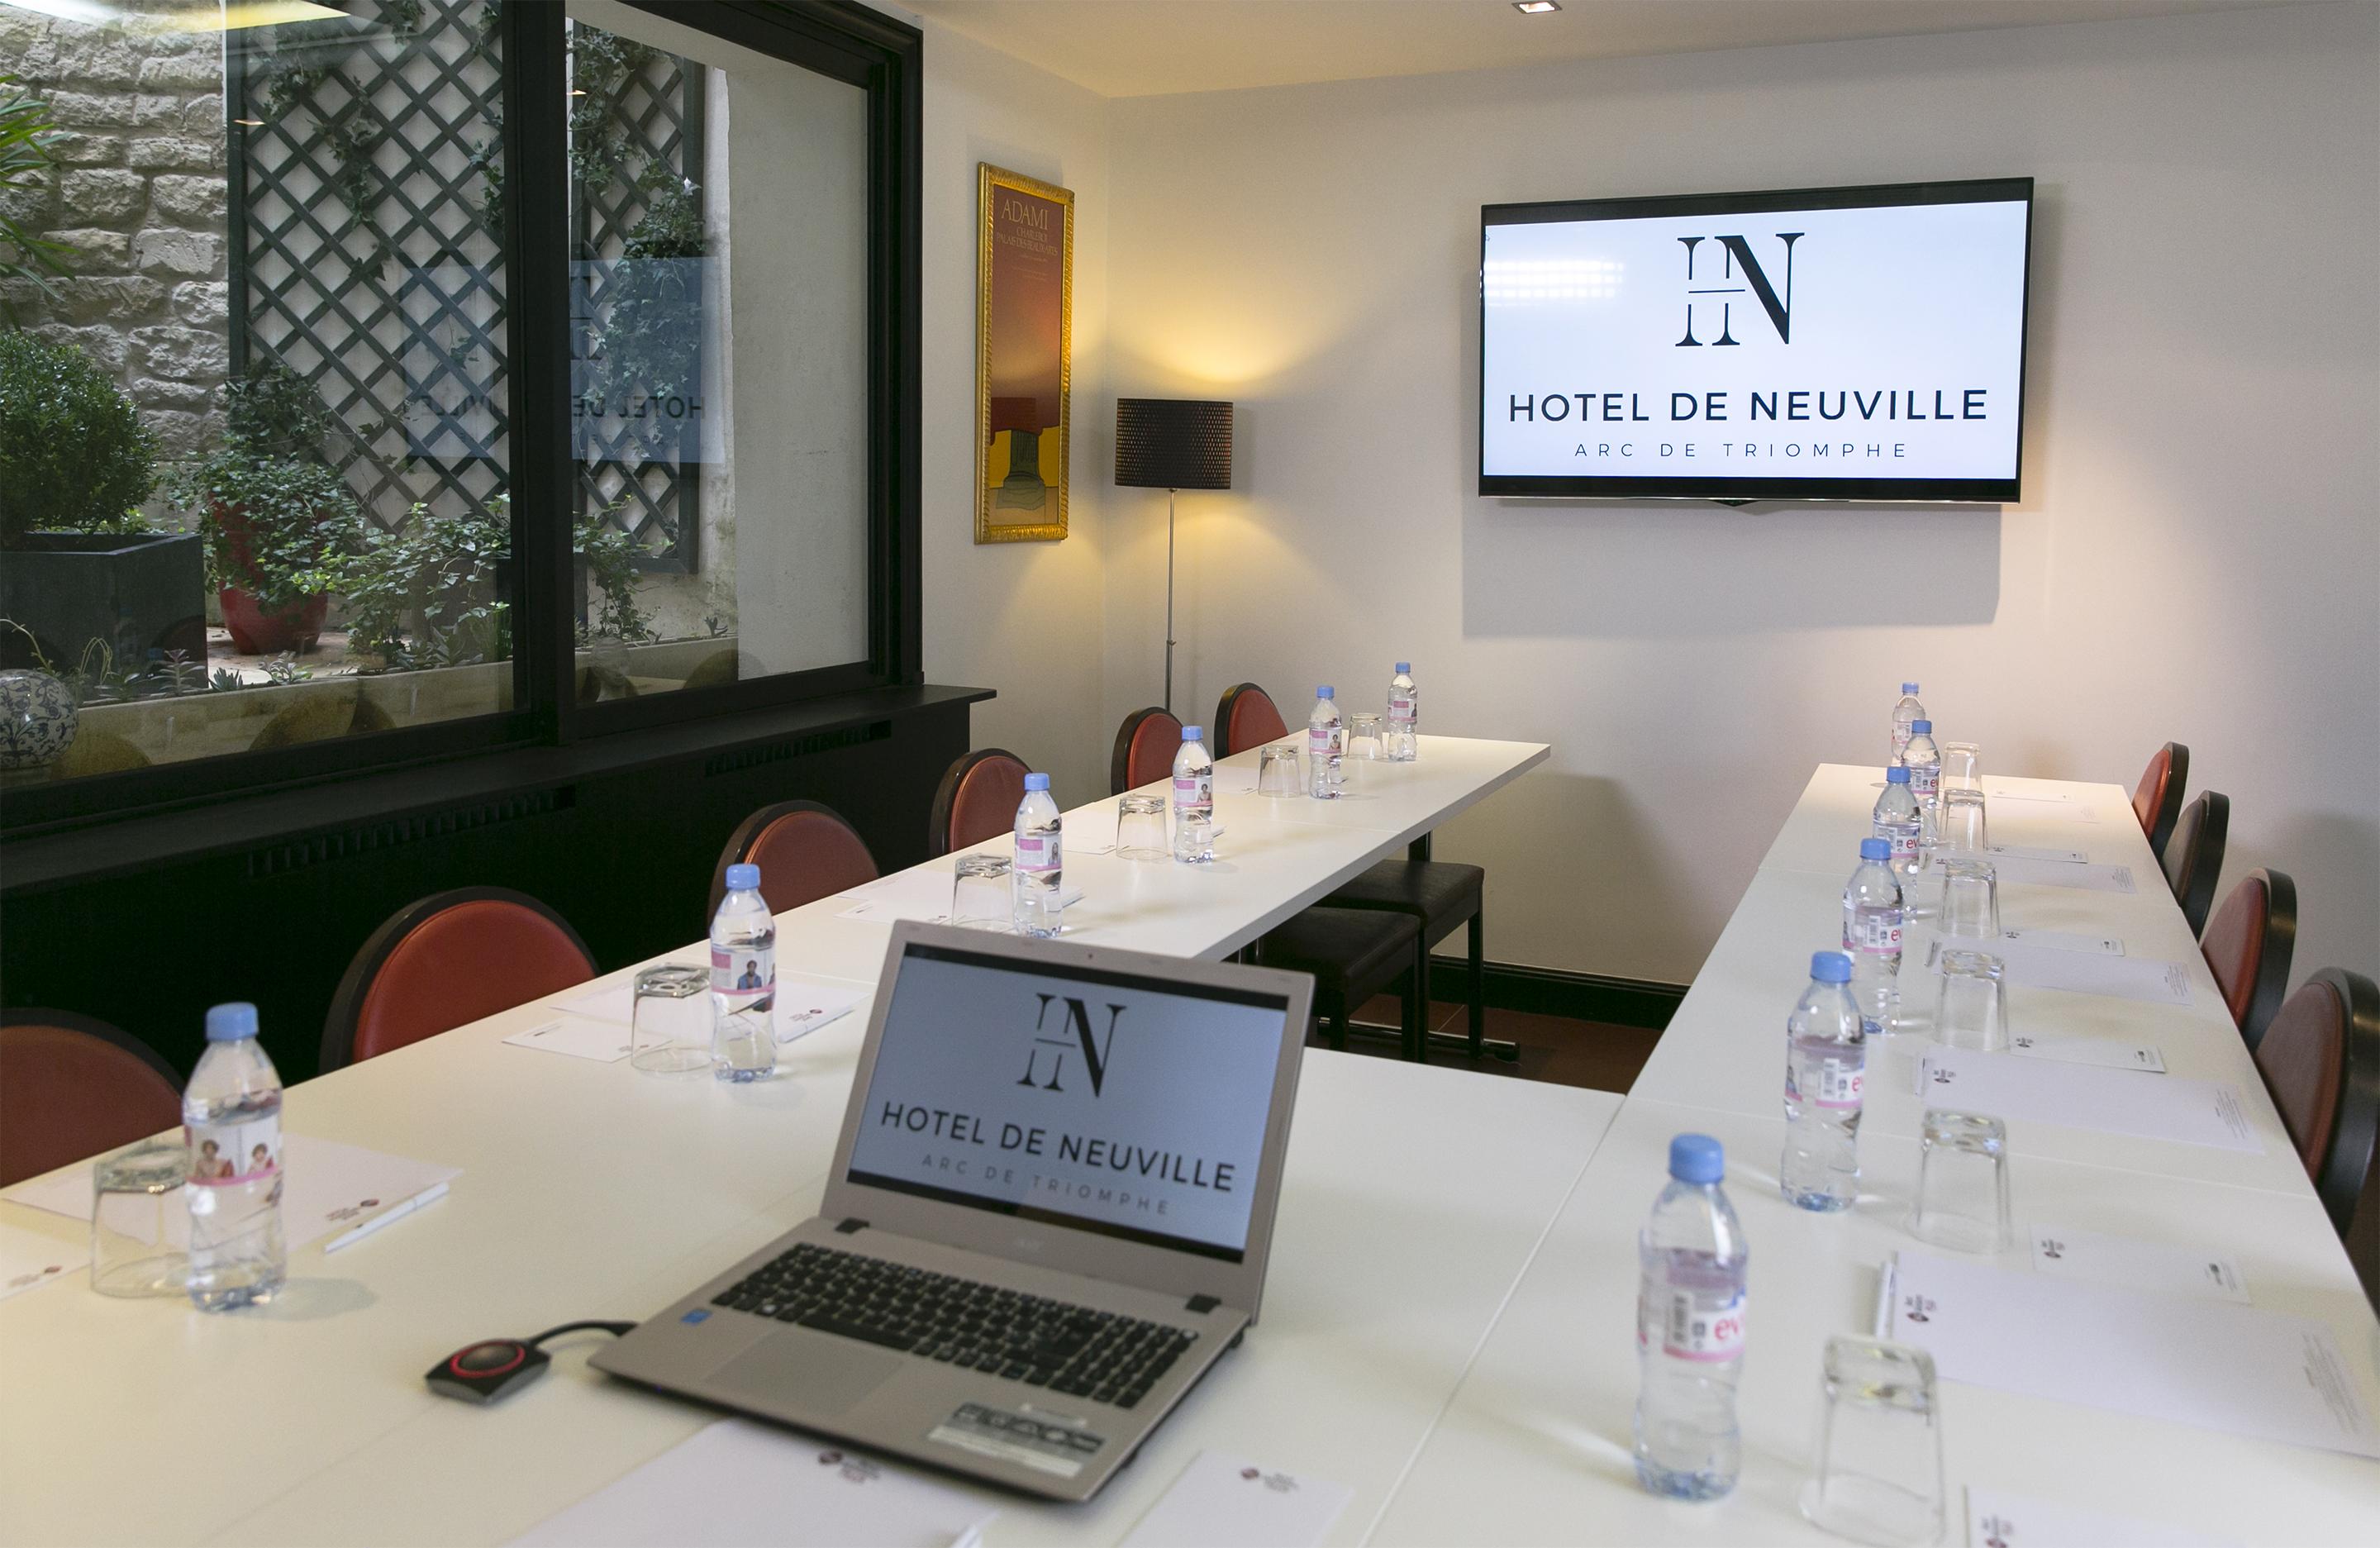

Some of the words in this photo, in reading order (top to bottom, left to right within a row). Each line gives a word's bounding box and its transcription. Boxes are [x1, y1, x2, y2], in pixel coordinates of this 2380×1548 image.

[1001, 198, 1049, 231] ADAMI
[1510, 393, 1649, 422] HOTEL
[1671, 392, 1728, 422] DE
[1750, 389, 1988, 421] NEUVILLE
[1574, 443, 1633, 458] ARC
[1660, 443, 1697, 458] DE
[1722, 442, 1906, 458] TRIOMPHE
[880, 1100, 983, 1146] HOTEL
[1000, 1124, 1045, 1155] DE
[1058, 1134, 1236, 1192] NEUVILLE
[921, 1155, 969, 1176] ARC
[985, 1165, 1014, 1185] DE
[1032, 1174, 1170, 1216] TRIOMPHE
